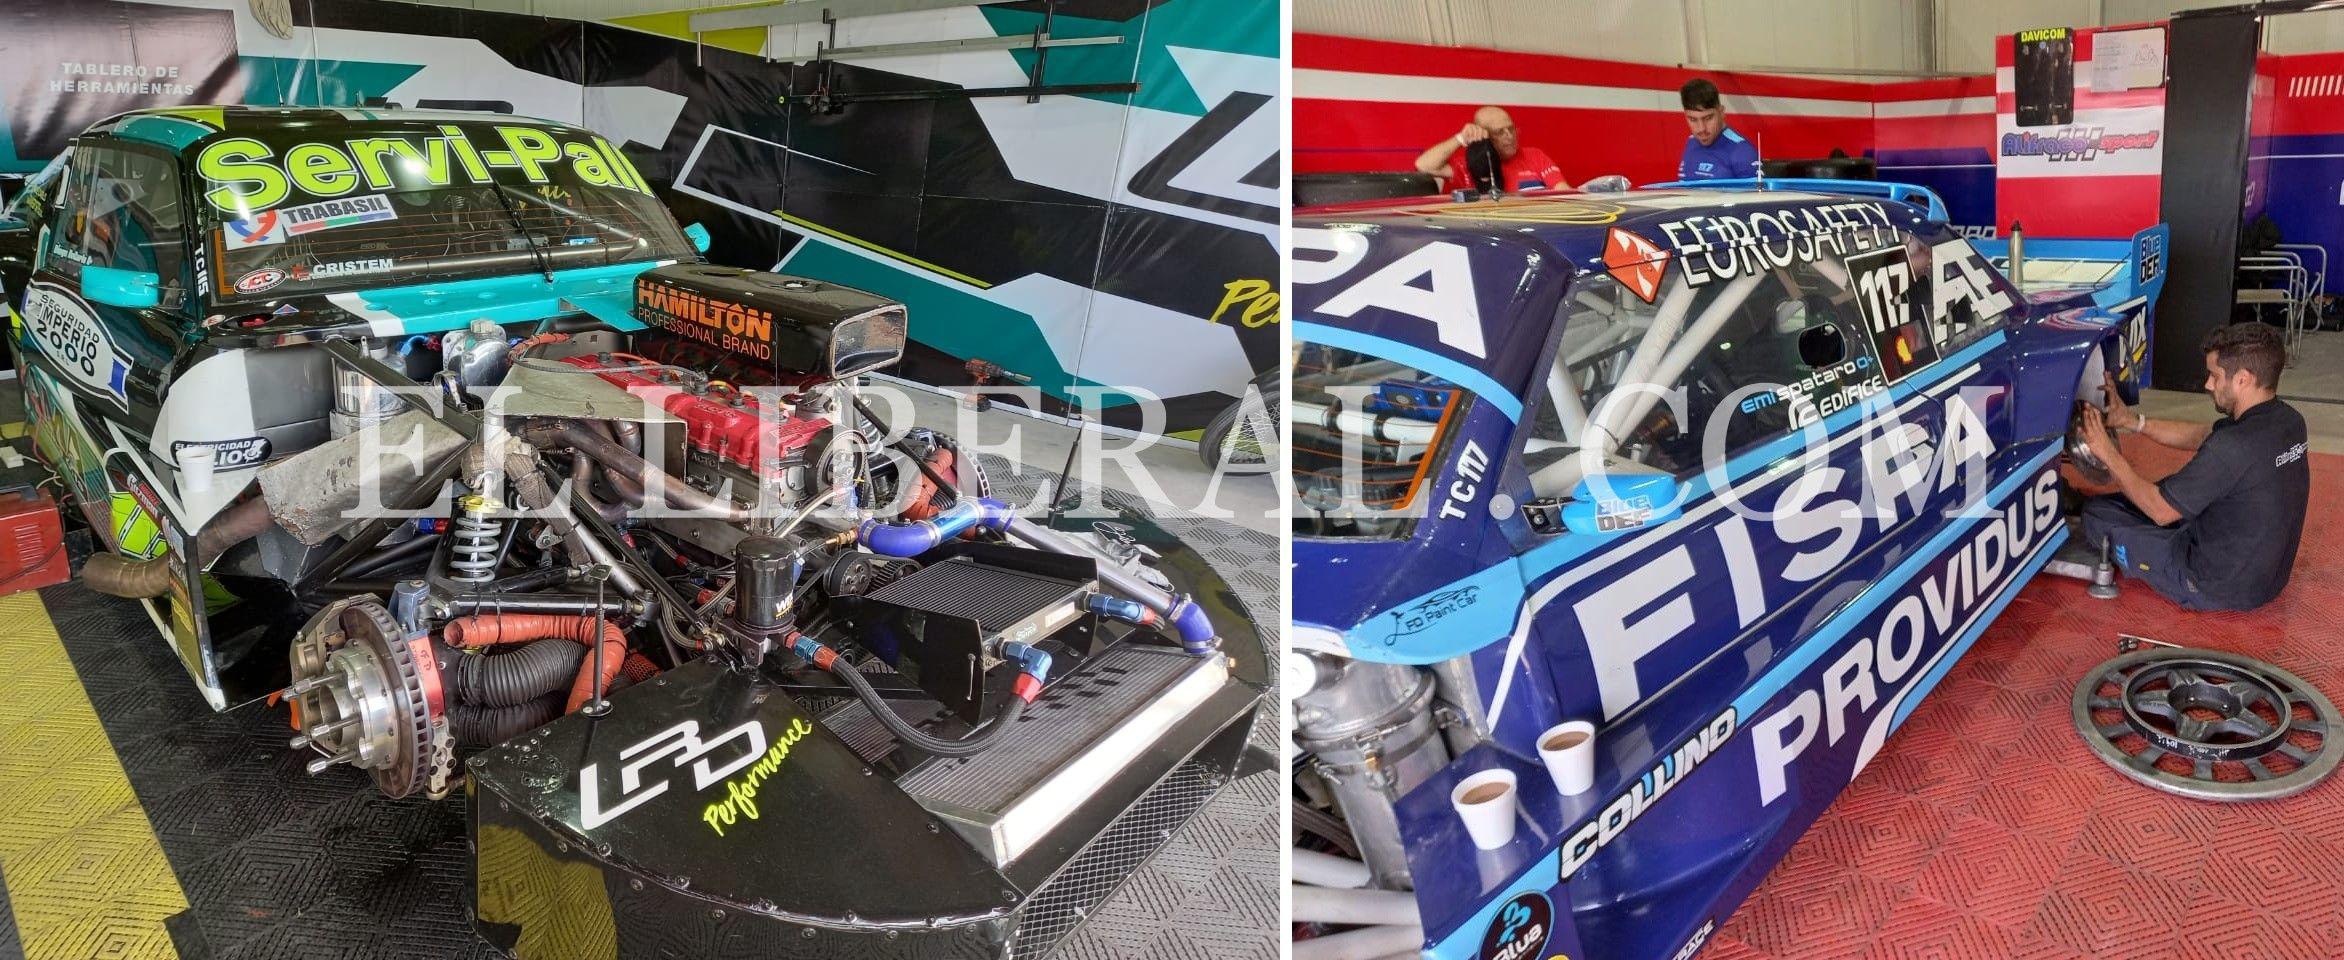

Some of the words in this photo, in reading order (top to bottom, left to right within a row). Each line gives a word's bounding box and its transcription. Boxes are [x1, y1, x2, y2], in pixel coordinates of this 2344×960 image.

[2021, 28, 2066, 42] DAVICOM
[49, 80, 194, 96] HERRAMIENTAS
[61, 62, 147, 76] TABLERO
[155, 66, 179, 78] DE
[283, 197, 389, 224] TRABASIL
[312, 258, 393, 275] CRISTEM
[1659, 202, 1900, 289] EUROSAFETY
[40, 294, 100, 344] SEGURIDAD
[638, 278, 772, 342] HAMILTON
[1859, 261, 1909, 334] 117
[37, 320, 95, 377] 2000
[638, 306, 718, 347] PROFESSIONAL
[722, 333, 770, 361] BRAND
[1819, 374, 1883, 417] EDIFICE
[1439, 439, 1489, 519] TC117
[1572, 393, 1996, 724] FISPA
[1425, 603, 1457, 622] Paint
[1456, 594, 1477, 609] Car
[1751, 469, 2058, 808] PROVIDUS
[703, 718, 813, 837] Performance
[1560, 706, 1737, 881] COLLINO
